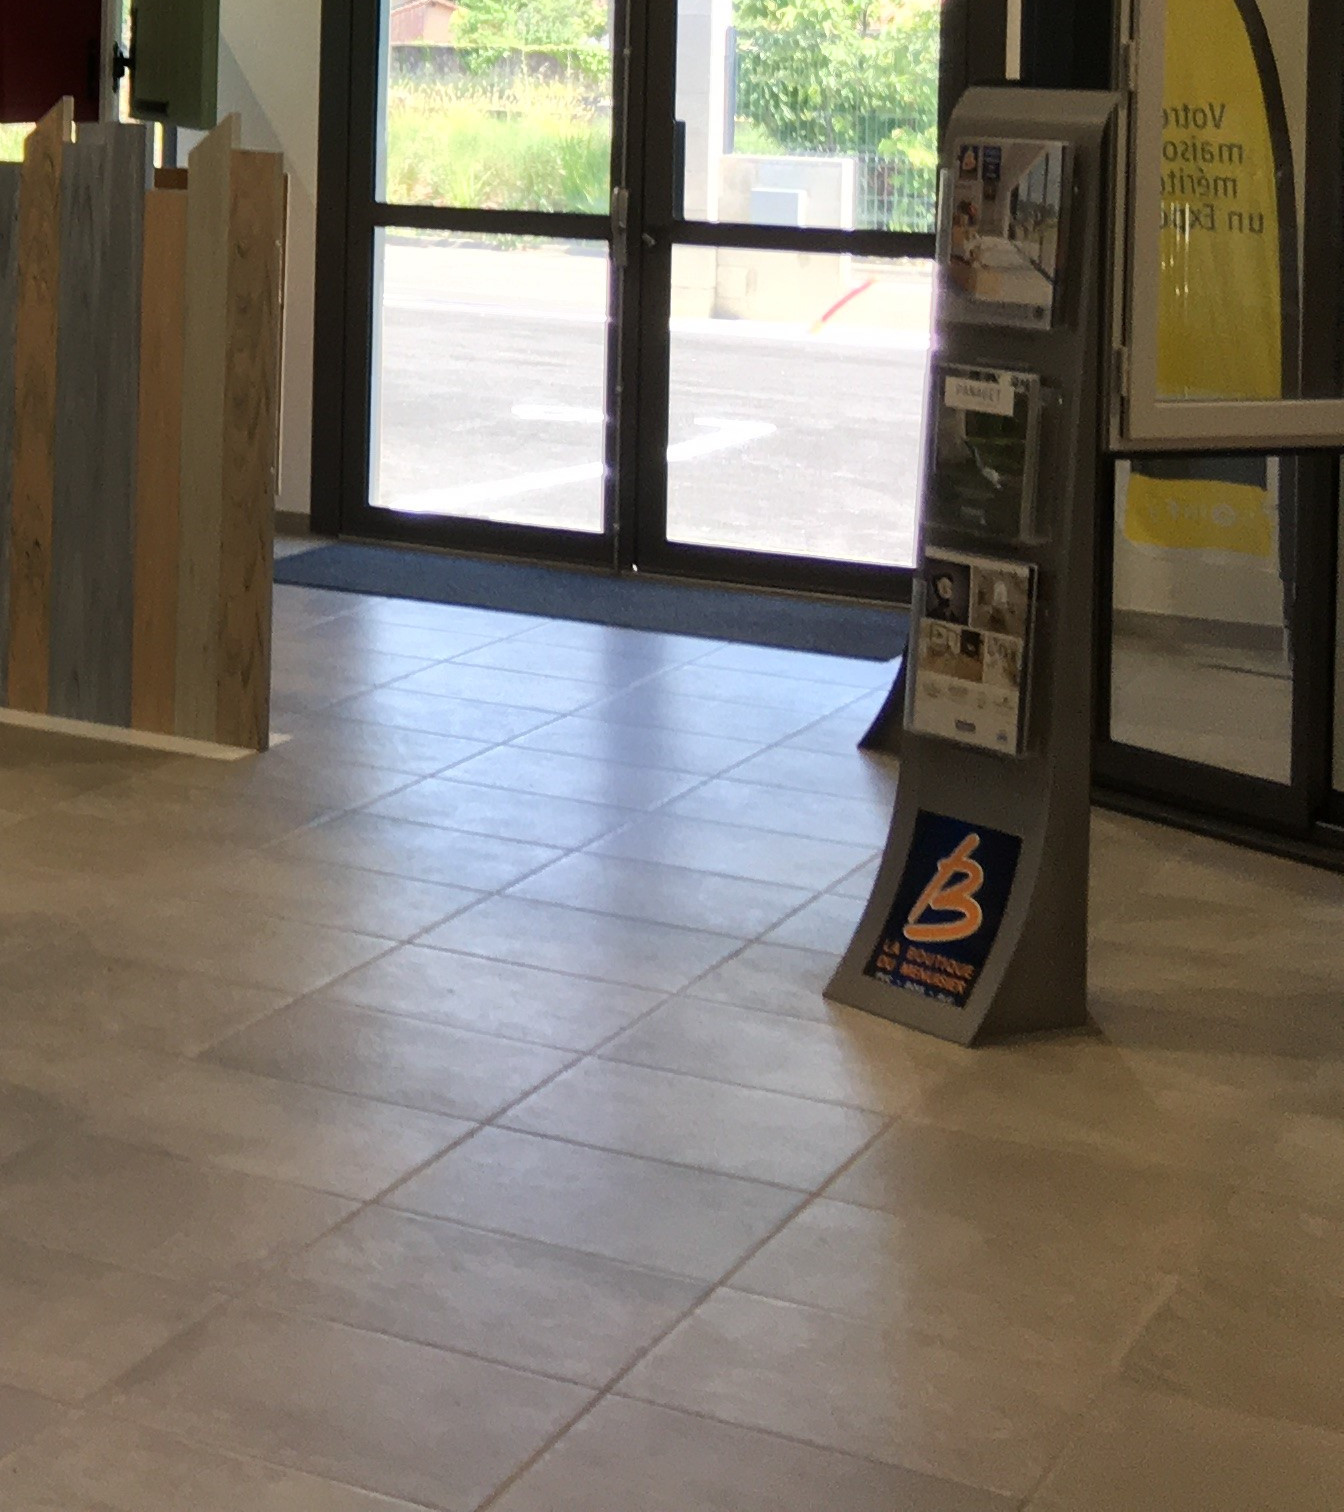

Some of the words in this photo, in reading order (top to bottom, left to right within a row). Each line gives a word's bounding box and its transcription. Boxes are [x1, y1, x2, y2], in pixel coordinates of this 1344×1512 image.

[903, 833, 985, 943] B
[876, 953, 896, 971] DU
[900, 961, 968, 995] MENUISIER
[906, 944, 975, 980] BOUTIQUE
